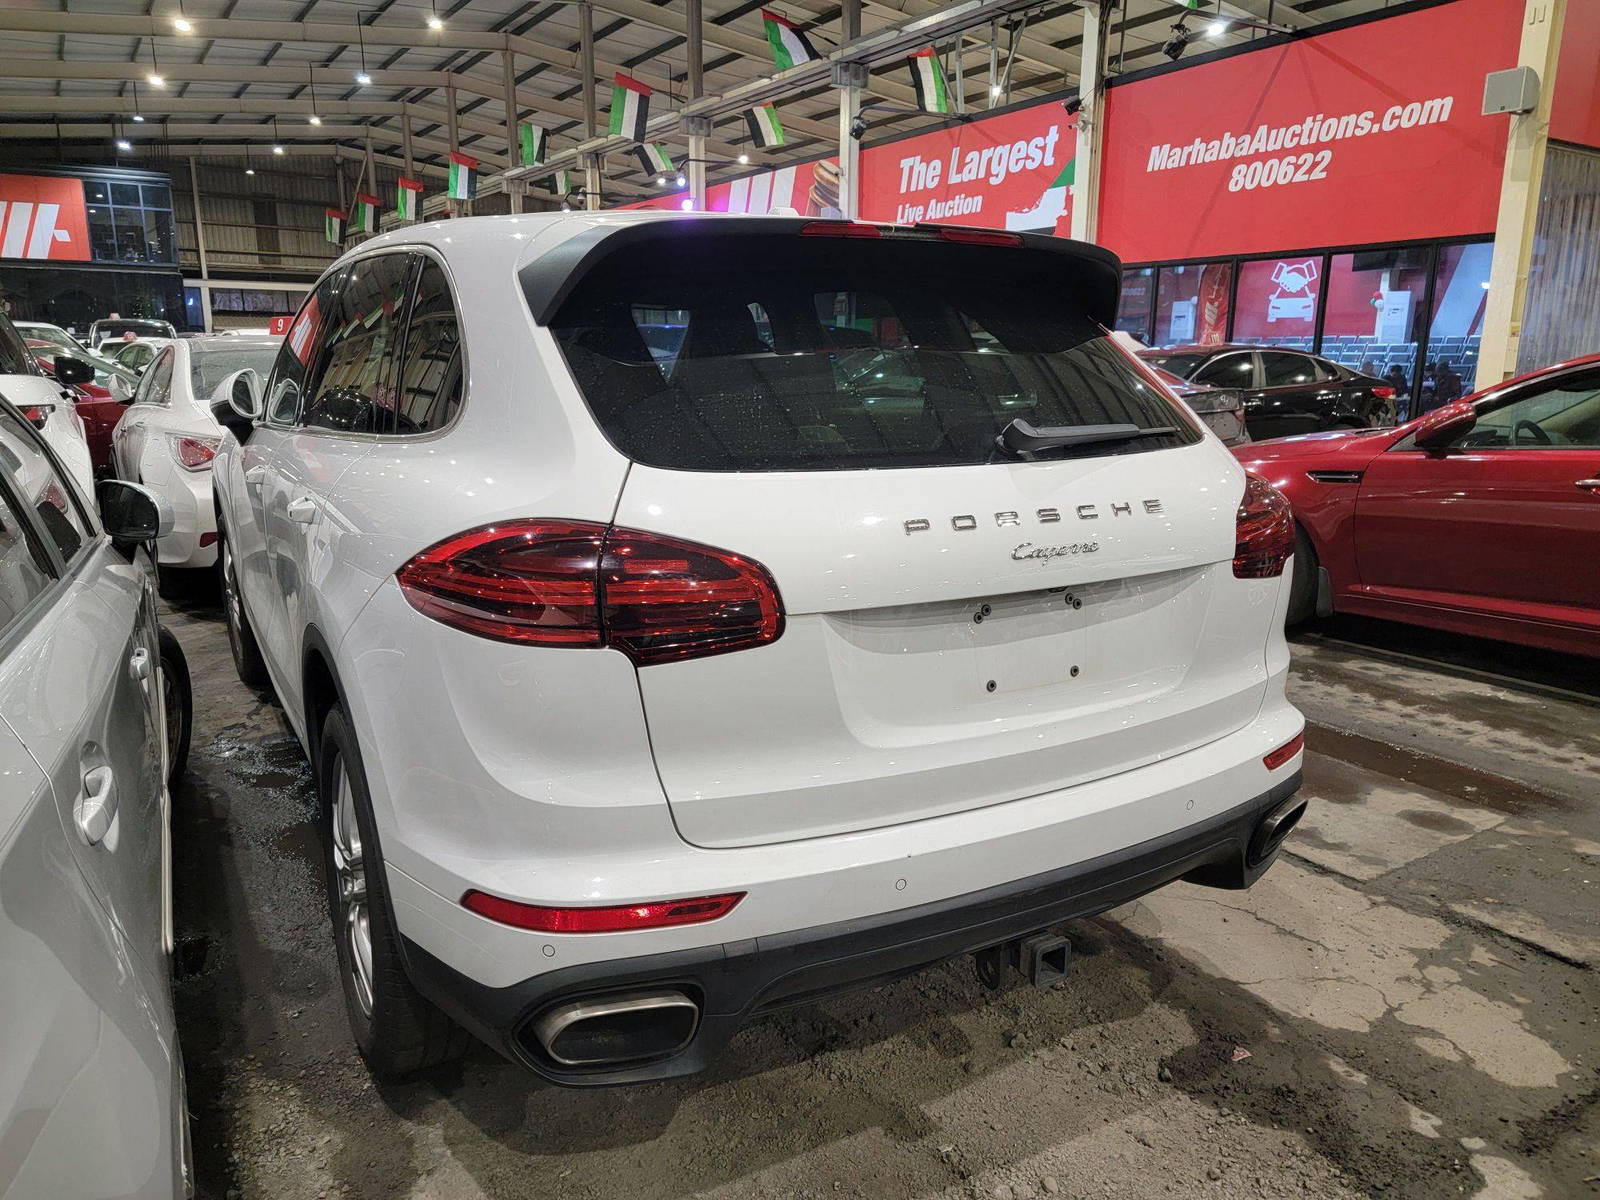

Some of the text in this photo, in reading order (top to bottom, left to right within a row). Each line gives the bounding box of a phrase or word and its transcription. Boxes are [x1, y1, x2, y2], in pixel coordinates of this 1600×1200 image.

[1146, 96, 1454, 172] MarhabaAuctions.com
[900, 125, 1059, 193] The Largest
[1228, 150, 1333, 192] 800622
[896, 194, 983, 224] Live Auction
[277, 318, 284, 332] 9
[903, 499, 1165, 536] PORSCHE
[1010, 541, 1099, 567] Cayenne
